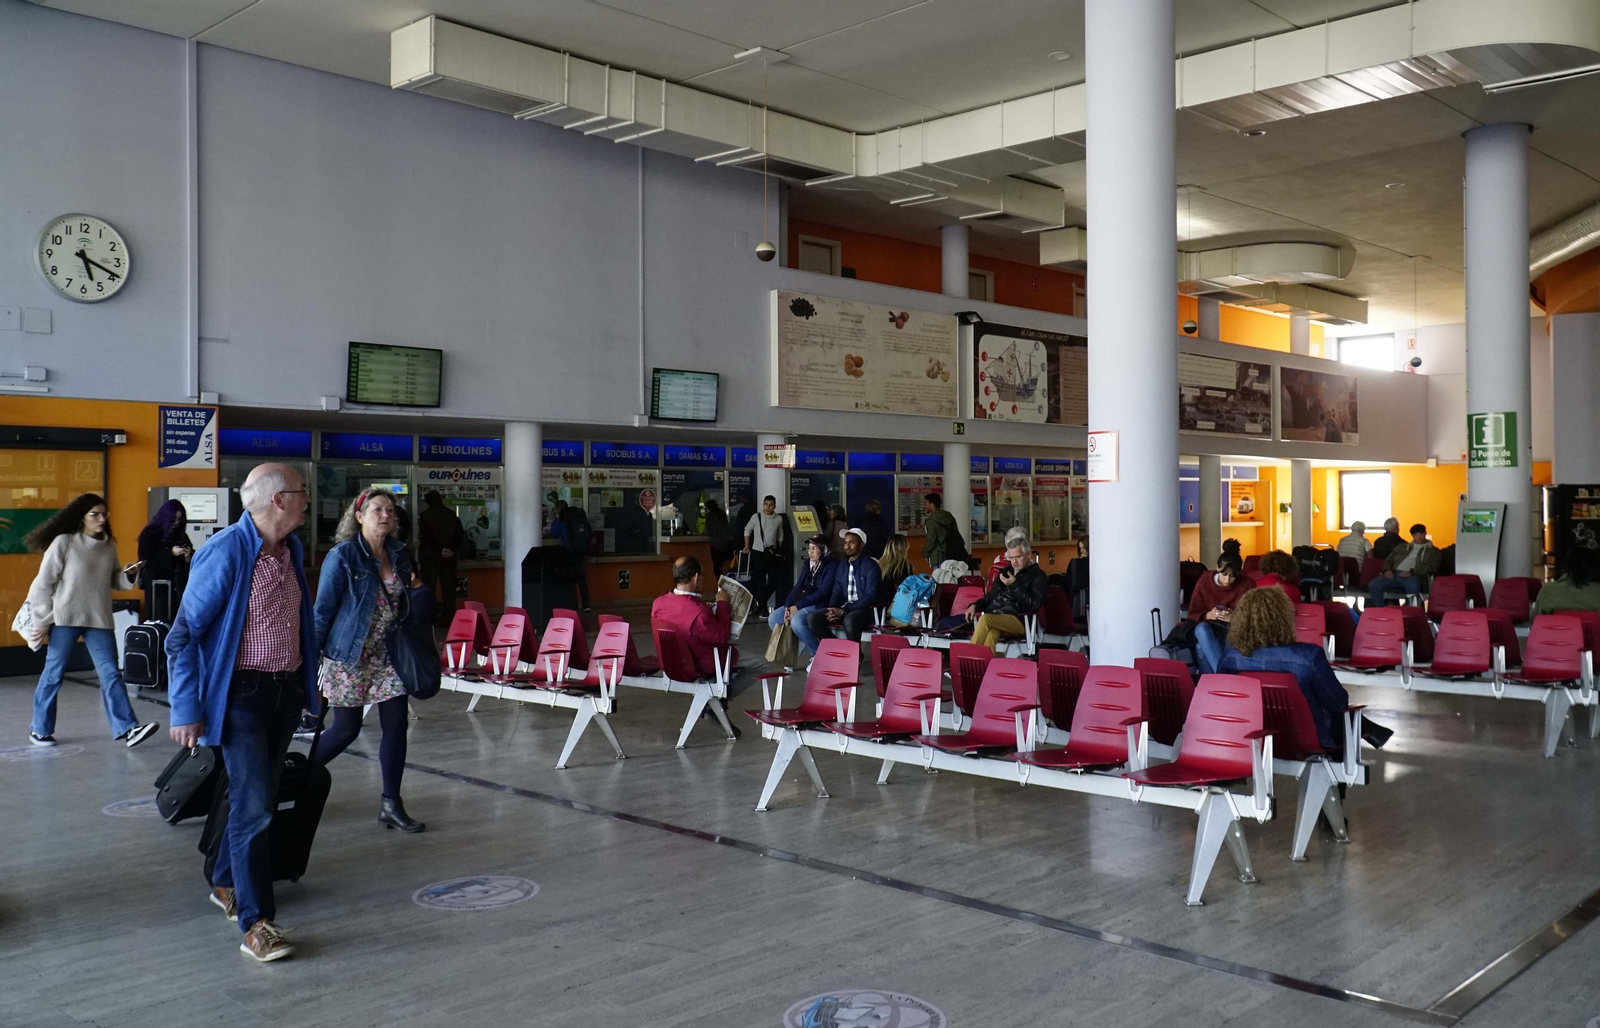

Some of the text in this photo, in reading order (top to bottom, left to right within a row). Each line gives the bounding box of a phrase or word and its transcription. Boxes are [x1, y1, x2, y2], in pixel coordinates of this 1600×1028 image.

[65, 224, 72, 236] 11
[80, 222, 90, 234] 12
[99, 228, 102, 238] 1
[52, 234, 62, 246] 10
[109, 241, 116, 252] 2
[46, 248, 53, 258] 9
[114, 258, 121, 268] 3
[50, 265, 58, 276] 8
[107, 273, 116, 282] 4
[66, 278, 73, 288] 7
[97, 282, 104, 292] 5
[80, 284, 87, 294] 6
[166, 410, 194, 418] VENTA
[167, 418, 206, 426] BILLETES
[252, 438, 279, 448] ALSA
[360, 443, 384, 452] ALSA
[205, 433, 213, 464] ALSA
[421, 445, 427, 454] 3
[431, 445, 492, 455] EUROLINES
[561, 449, 577, 457] S.A.
[606, 450, 652, 459] SOCIBUS S.A.
[1471, 459, 1511, 467] Información
